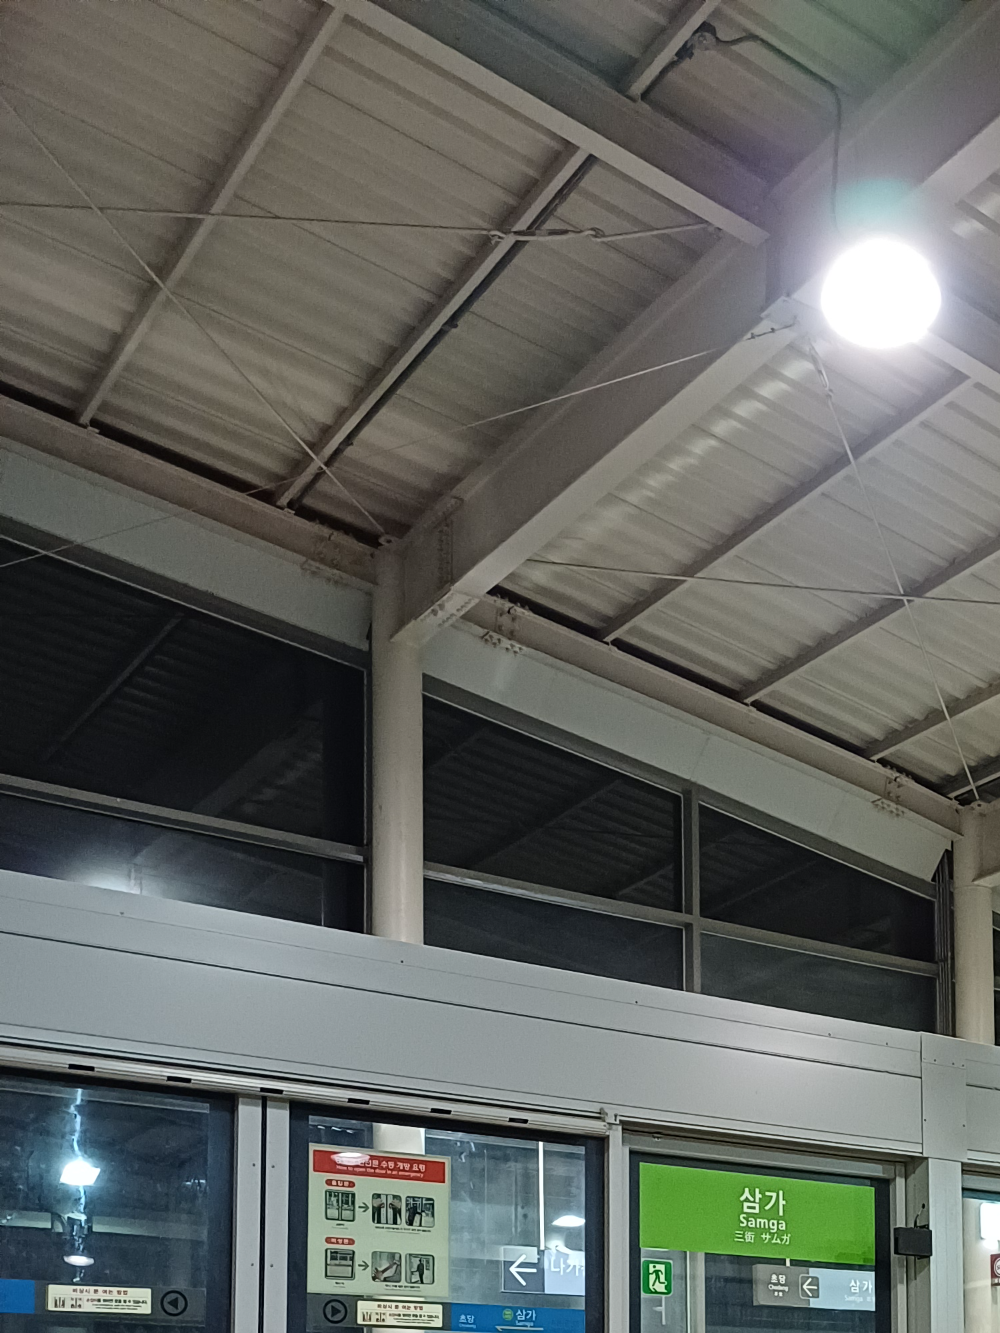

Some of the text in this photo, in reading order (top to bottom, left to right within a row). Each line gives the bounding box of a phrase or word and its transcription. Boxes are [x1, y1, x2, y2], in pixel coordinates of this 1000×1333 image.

[739, 1187, 786, 1216] 삼가
[739, 1214, 786, 1233] Samga
[734, 1231, 791, 1245] 三街 サムガ
[550, 1256, 585, 1277] 나가
[771, 1273, 786, 1284] 초당
[849, 1279, 872, 1294] 삼가
[459, 1314, 475, 1324] 초당
[516, 1309, 537, 1322] 삼가
